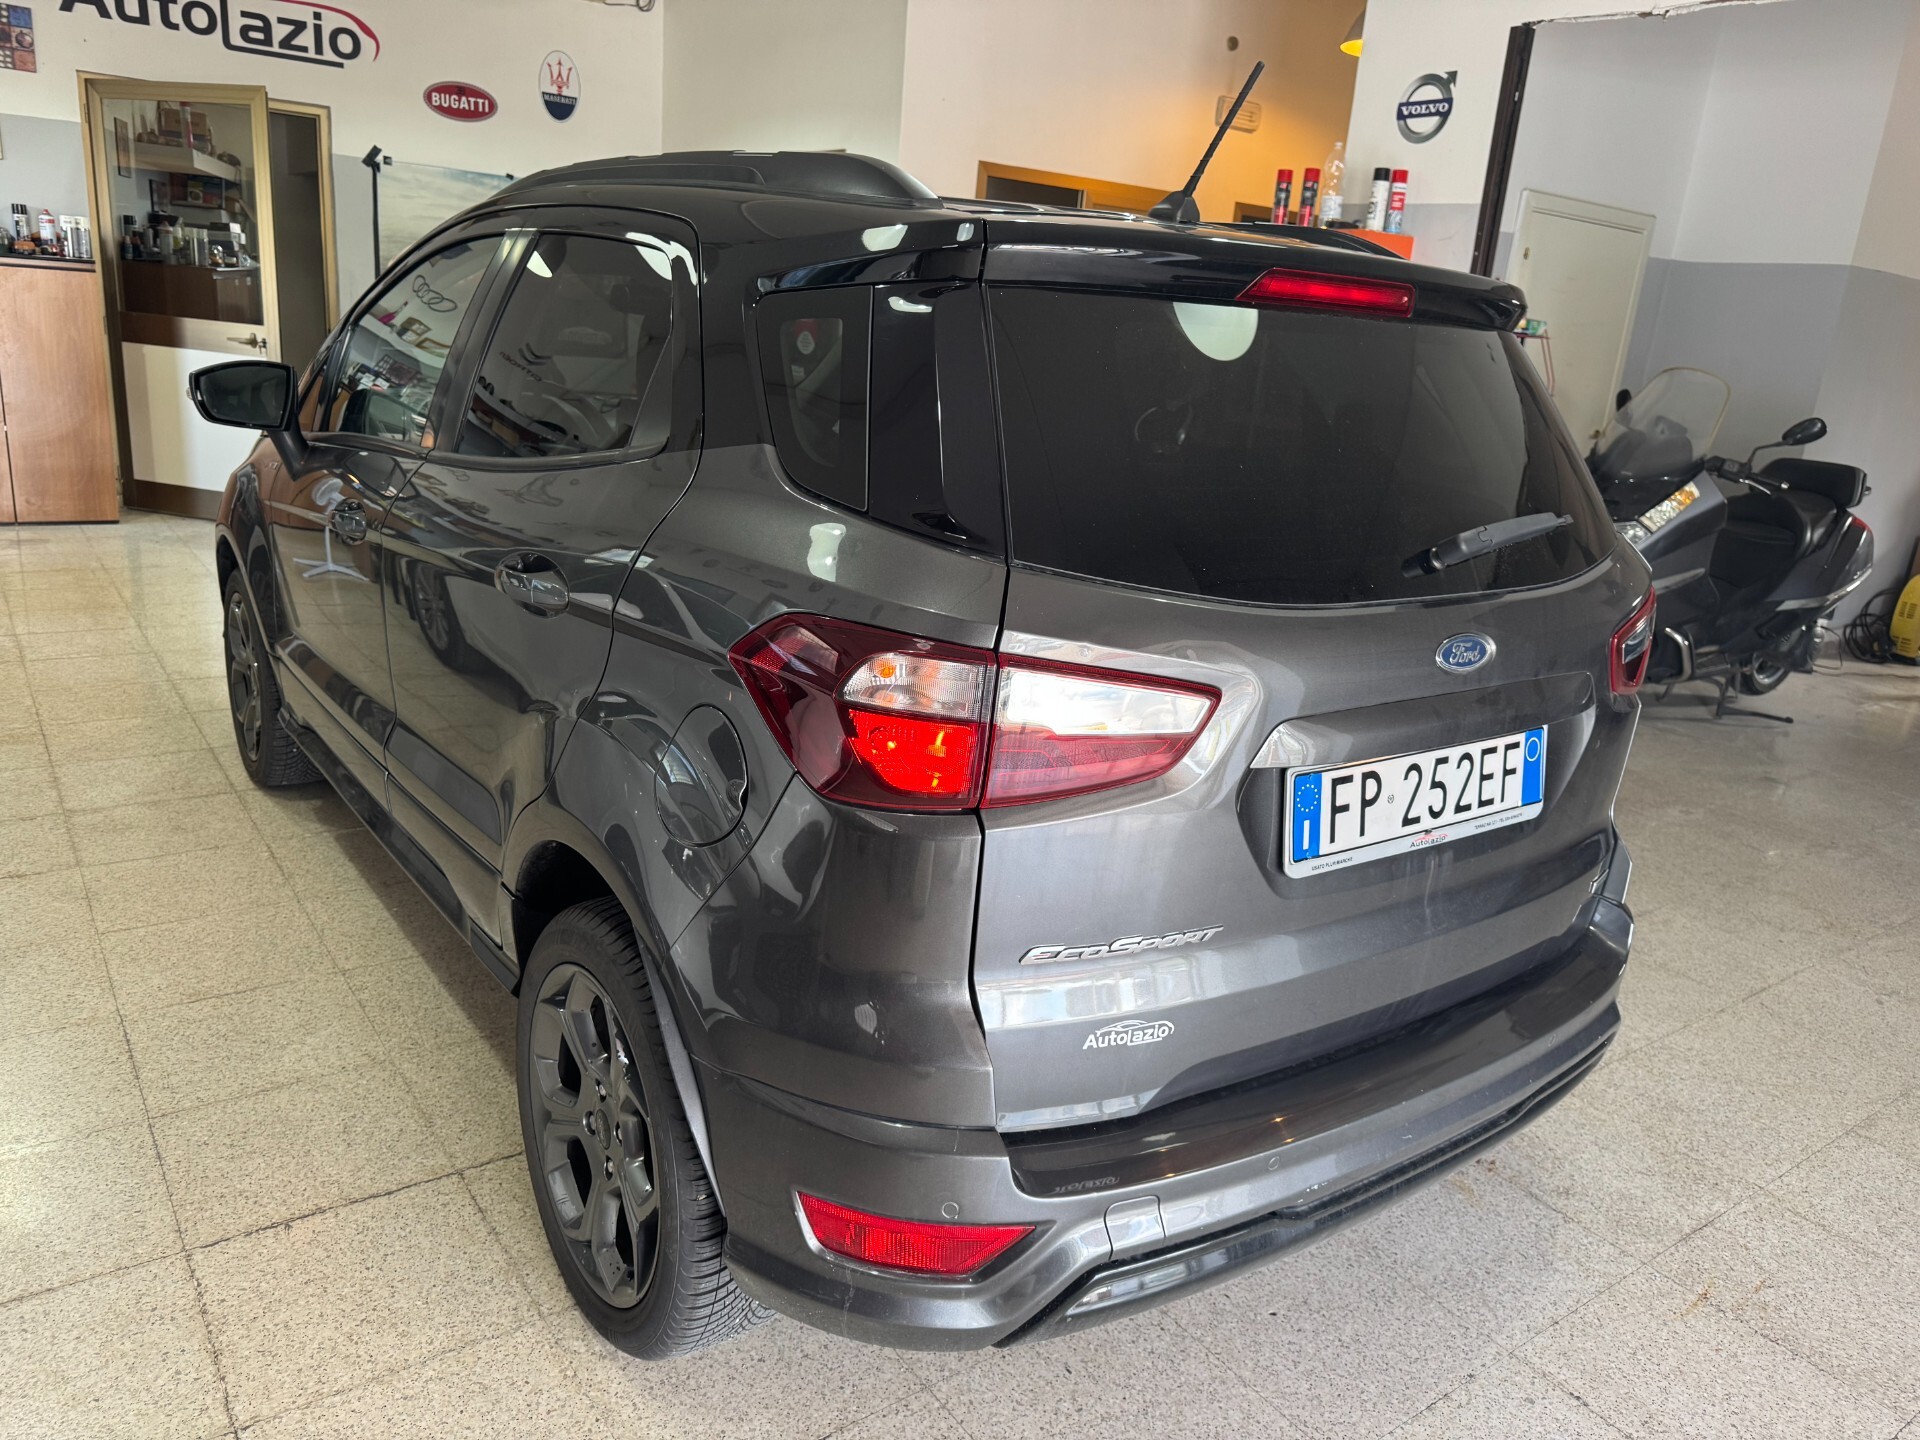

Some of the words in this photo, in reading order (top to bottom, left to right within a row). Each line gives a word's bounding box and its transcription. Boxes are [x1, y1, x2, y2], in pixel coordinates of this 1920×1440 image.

[430, 91, 490, 113] BUGATTI
[1400, 102, 1449, 116] VOLVO
[1449, 641, 1481, 665] Ford
[1329, 770, 1383, 845] FP
